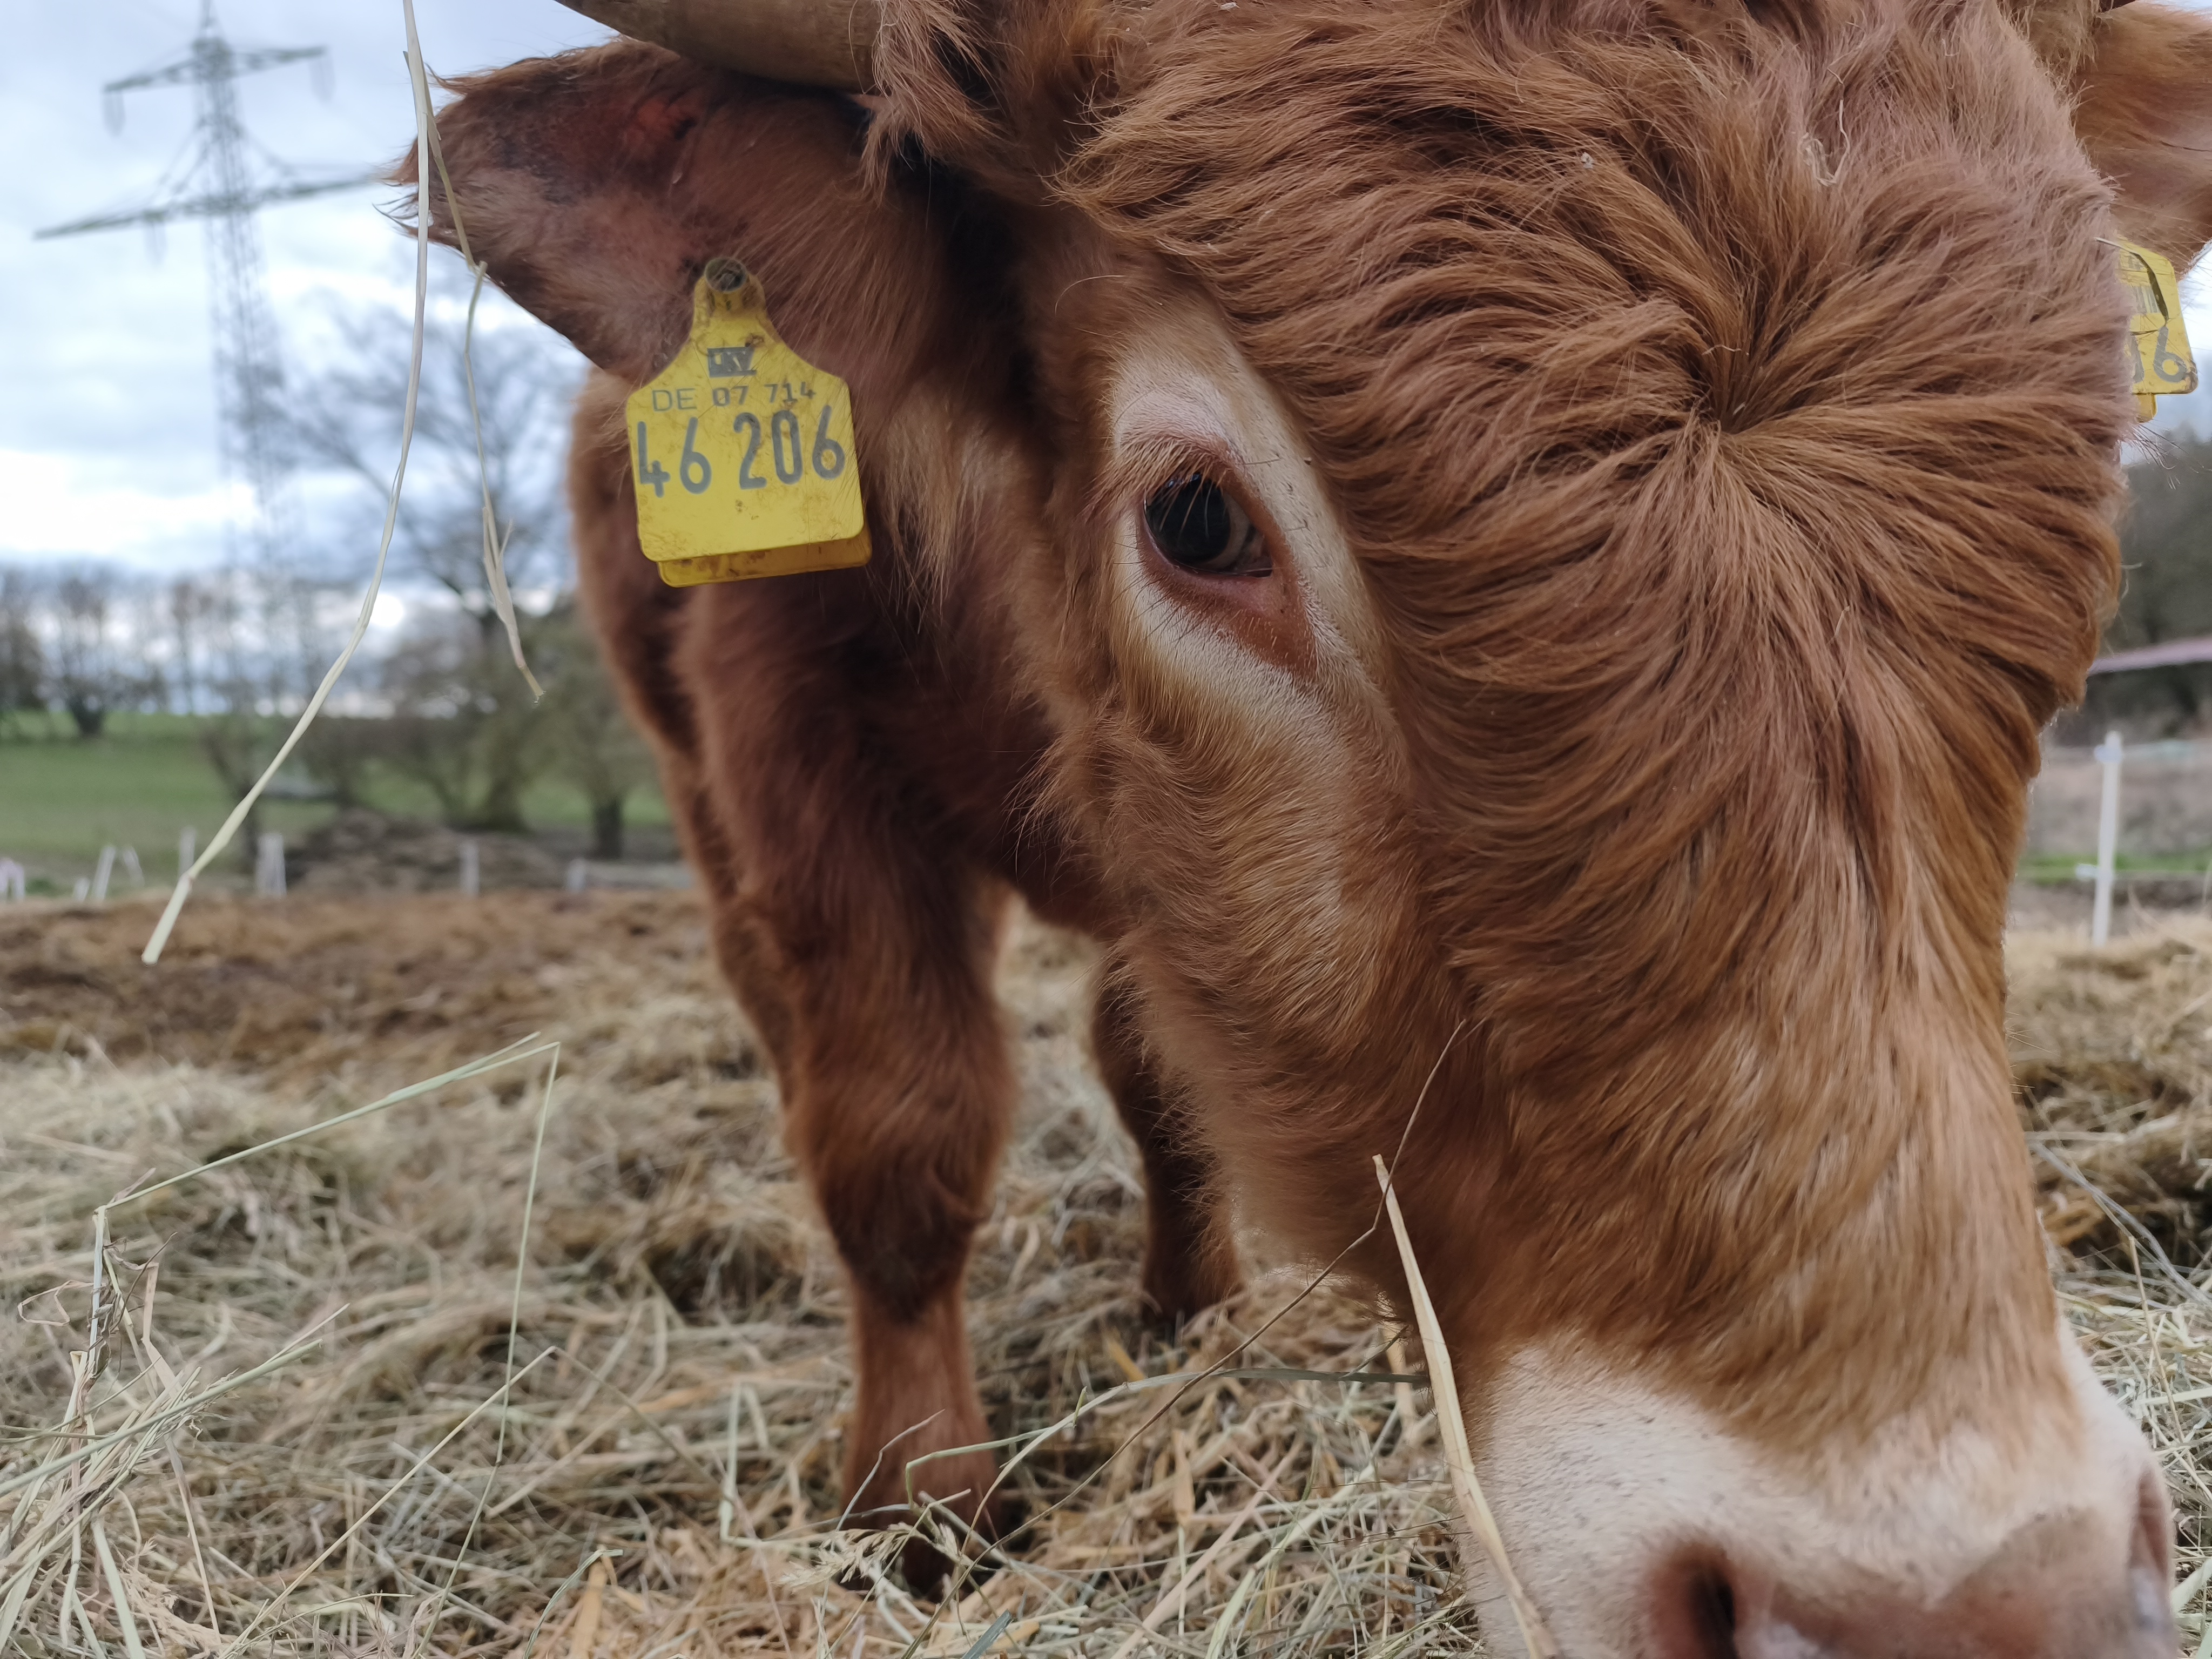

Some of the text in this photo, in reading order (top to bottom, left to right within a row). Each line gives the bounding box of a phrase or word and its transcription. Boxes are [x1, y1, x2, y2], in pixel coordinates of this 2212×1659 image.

[652, 381, 817, 412] DE 07 714
[637, 404, 846, 498] 46 206
